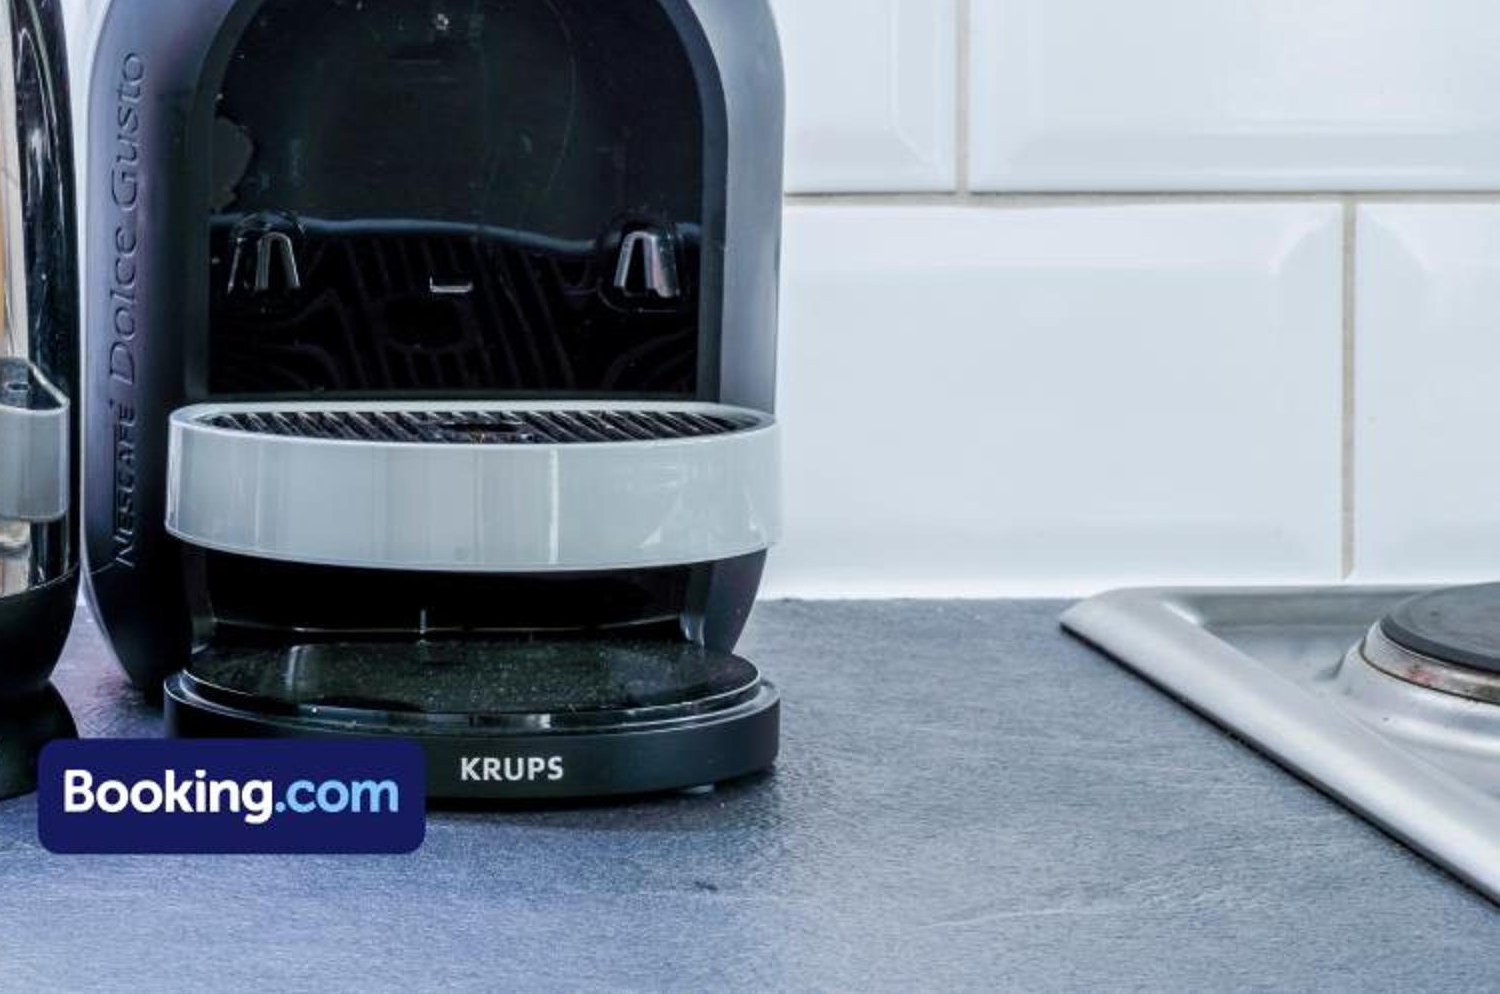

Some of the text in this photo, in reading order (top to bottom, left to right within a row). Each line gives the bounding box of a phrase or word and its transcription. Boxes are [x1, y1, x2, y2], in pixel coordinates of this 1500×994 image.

[111, 52, 145, 212] Gusto
[110, 226, 137, 385] Dolce
[460, 756, 564, 781] KRUPS
